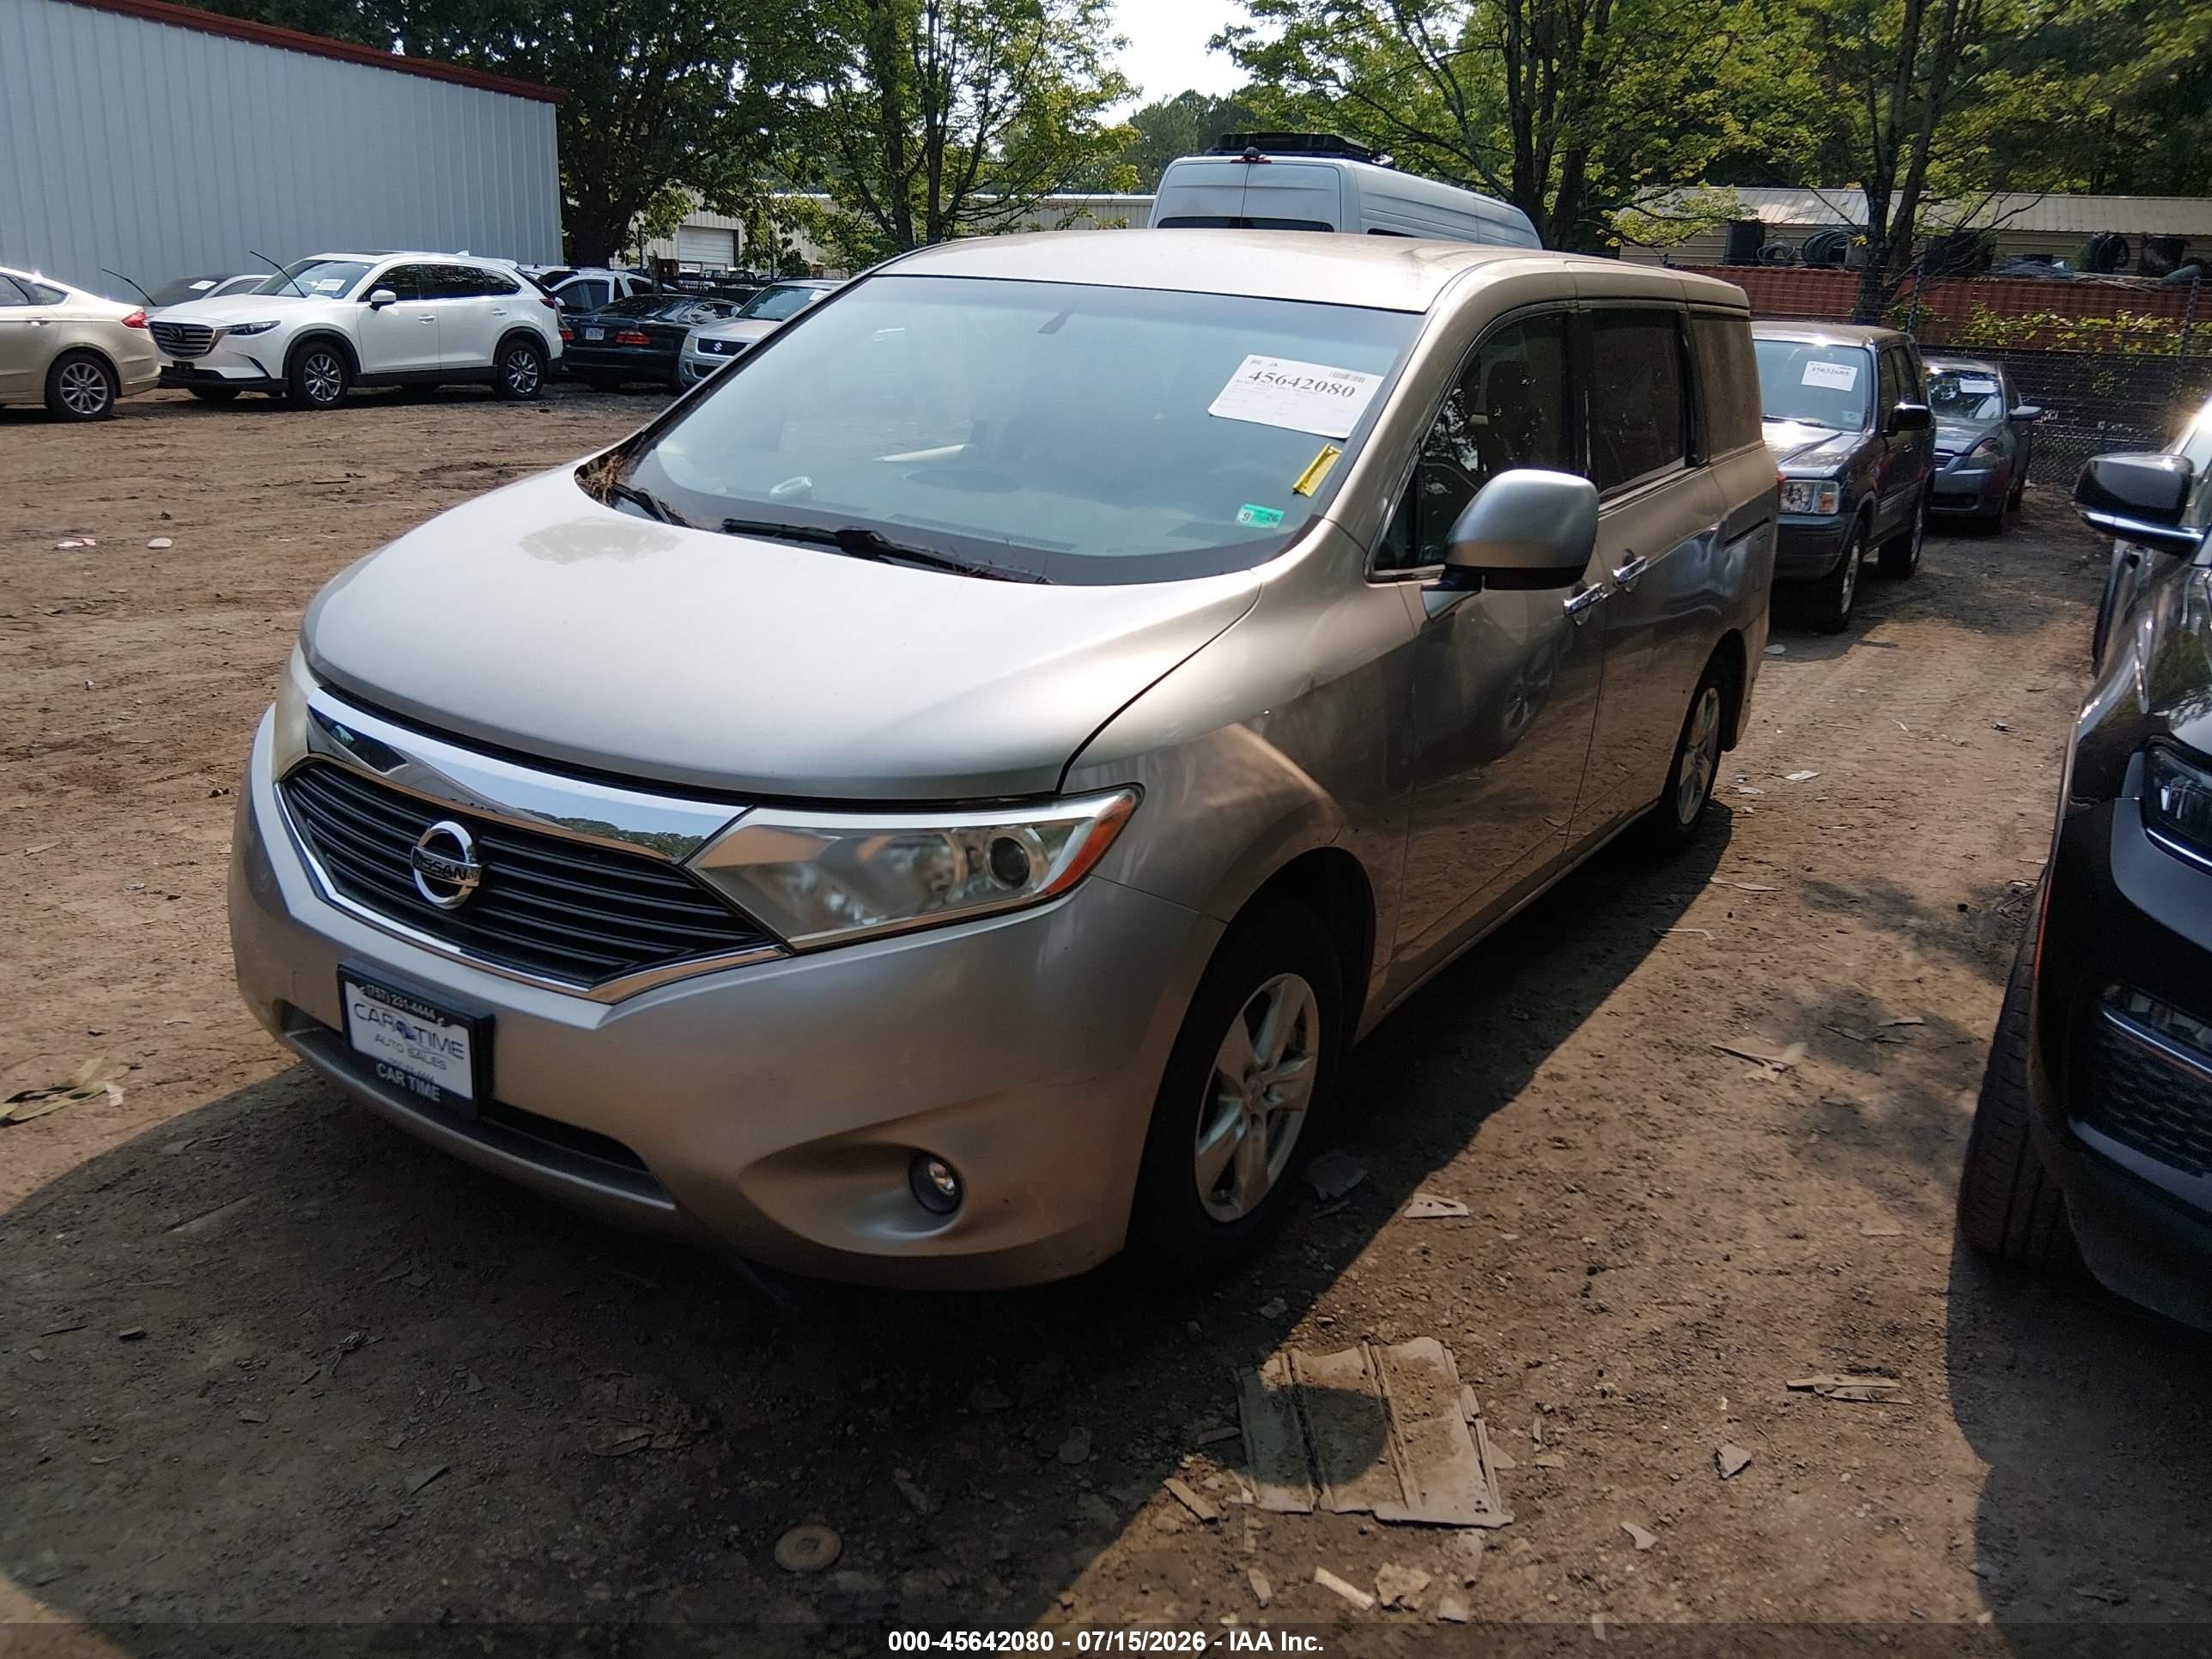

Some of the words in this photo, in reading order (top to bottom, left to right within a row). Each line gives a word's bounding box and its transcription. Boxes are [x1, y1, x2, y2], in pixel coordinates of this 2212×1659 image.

[1249, 370, 1355, 398] 45642080
[413, 847, 469, 881] NISSAN
[354, 1002, 397, 1031] CAR
[414, 1026, 465, 1060] TIME
[374, 1033, 404, 1054] AUTO
[407, 1047, 448, 1071] SALES
[375, 1062, 405, 1087] CAR
[408, 1073, 441, 1103] TIME
